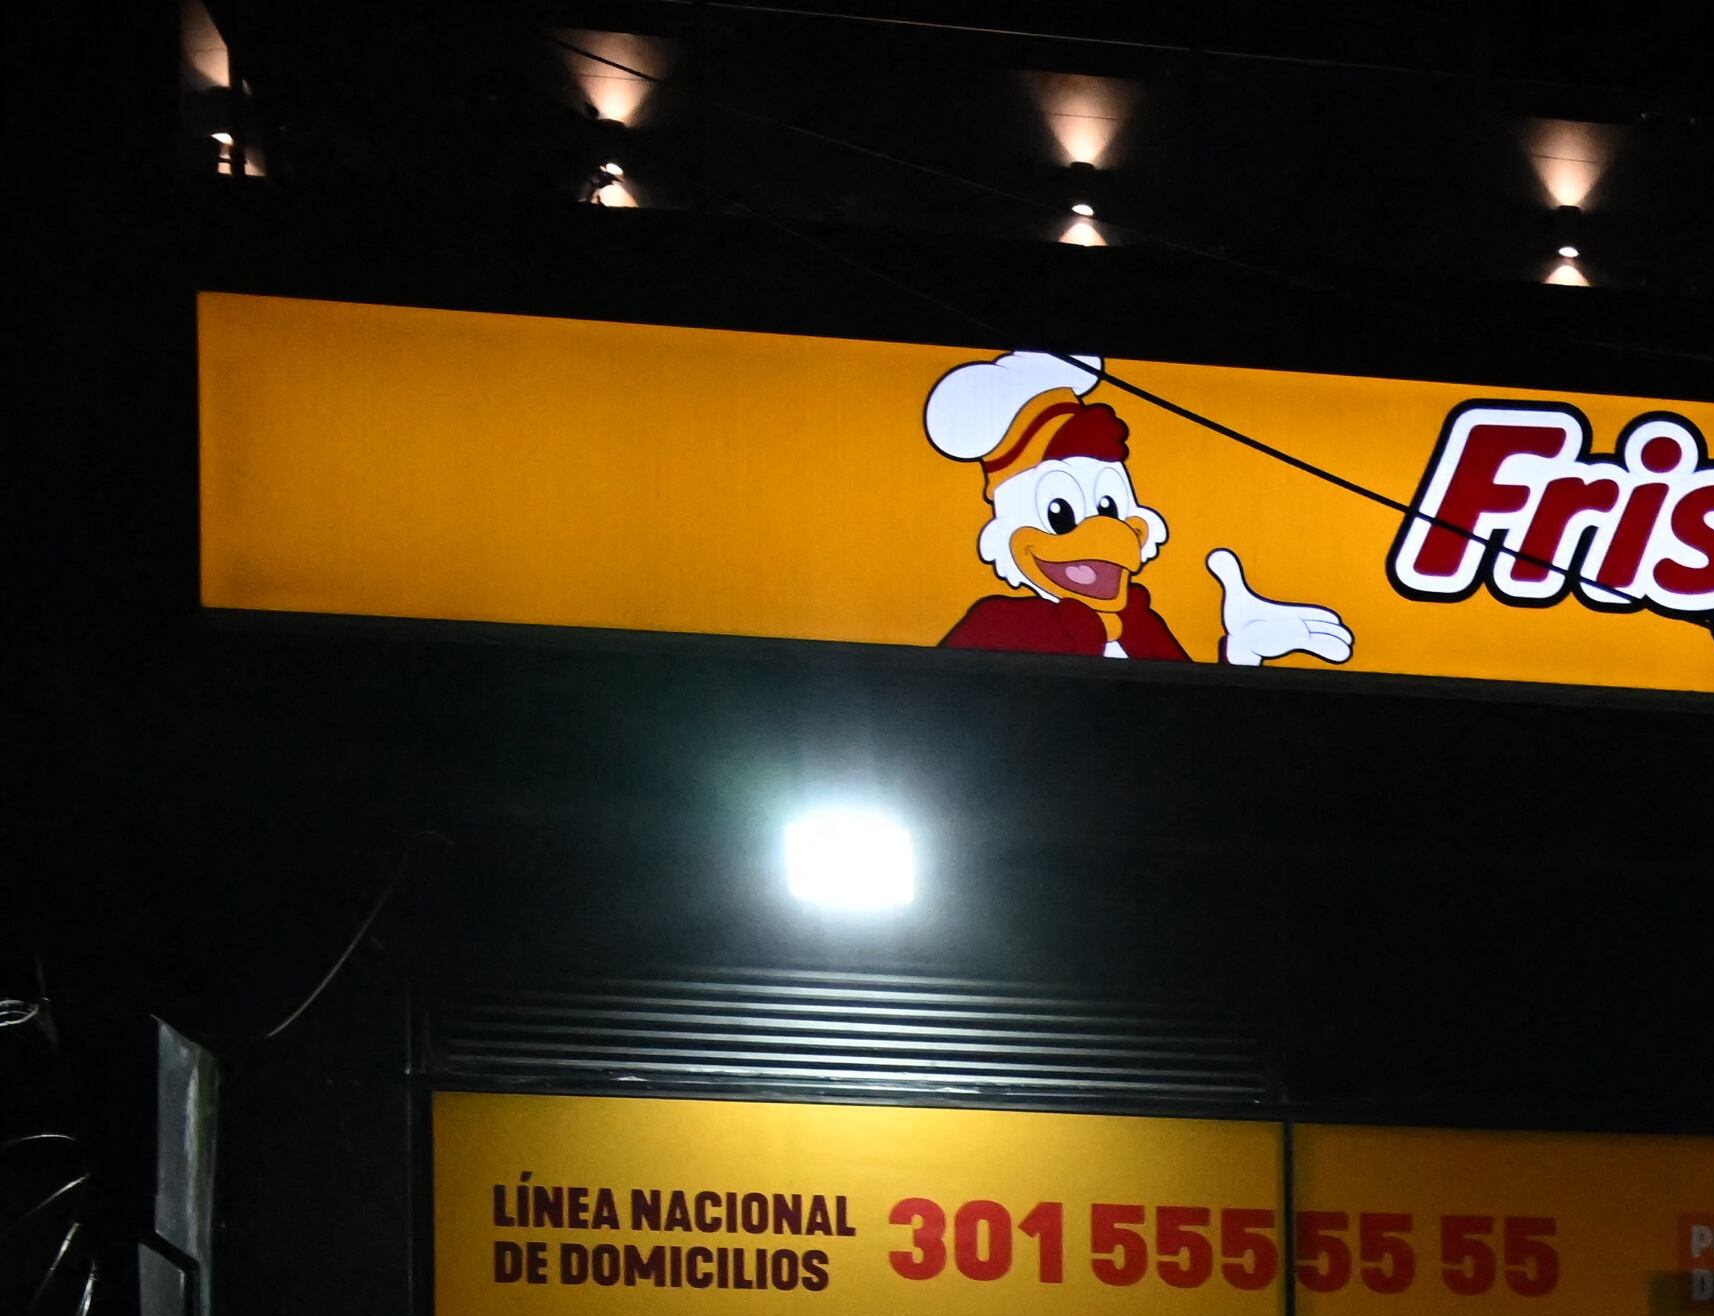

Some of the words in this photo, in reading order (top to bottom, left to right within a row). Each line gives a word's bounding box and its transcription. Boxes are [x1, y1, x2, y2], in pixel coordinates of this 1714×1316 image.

[493, 1171, 619, 1229] LÍNEA
[630, 1189, 857, 1238] NACIONAL
[493, 1240, 548, 1286] DE
[560, 1242, 830, 1292] DOMICILIOS
[888, 1197, 1064, 1284] 301
[1090, 1203, 1279, 1291] 555
[1295, 1210, 1416, 1294] 55
[1440, 1215, 1560, 1298] 55
